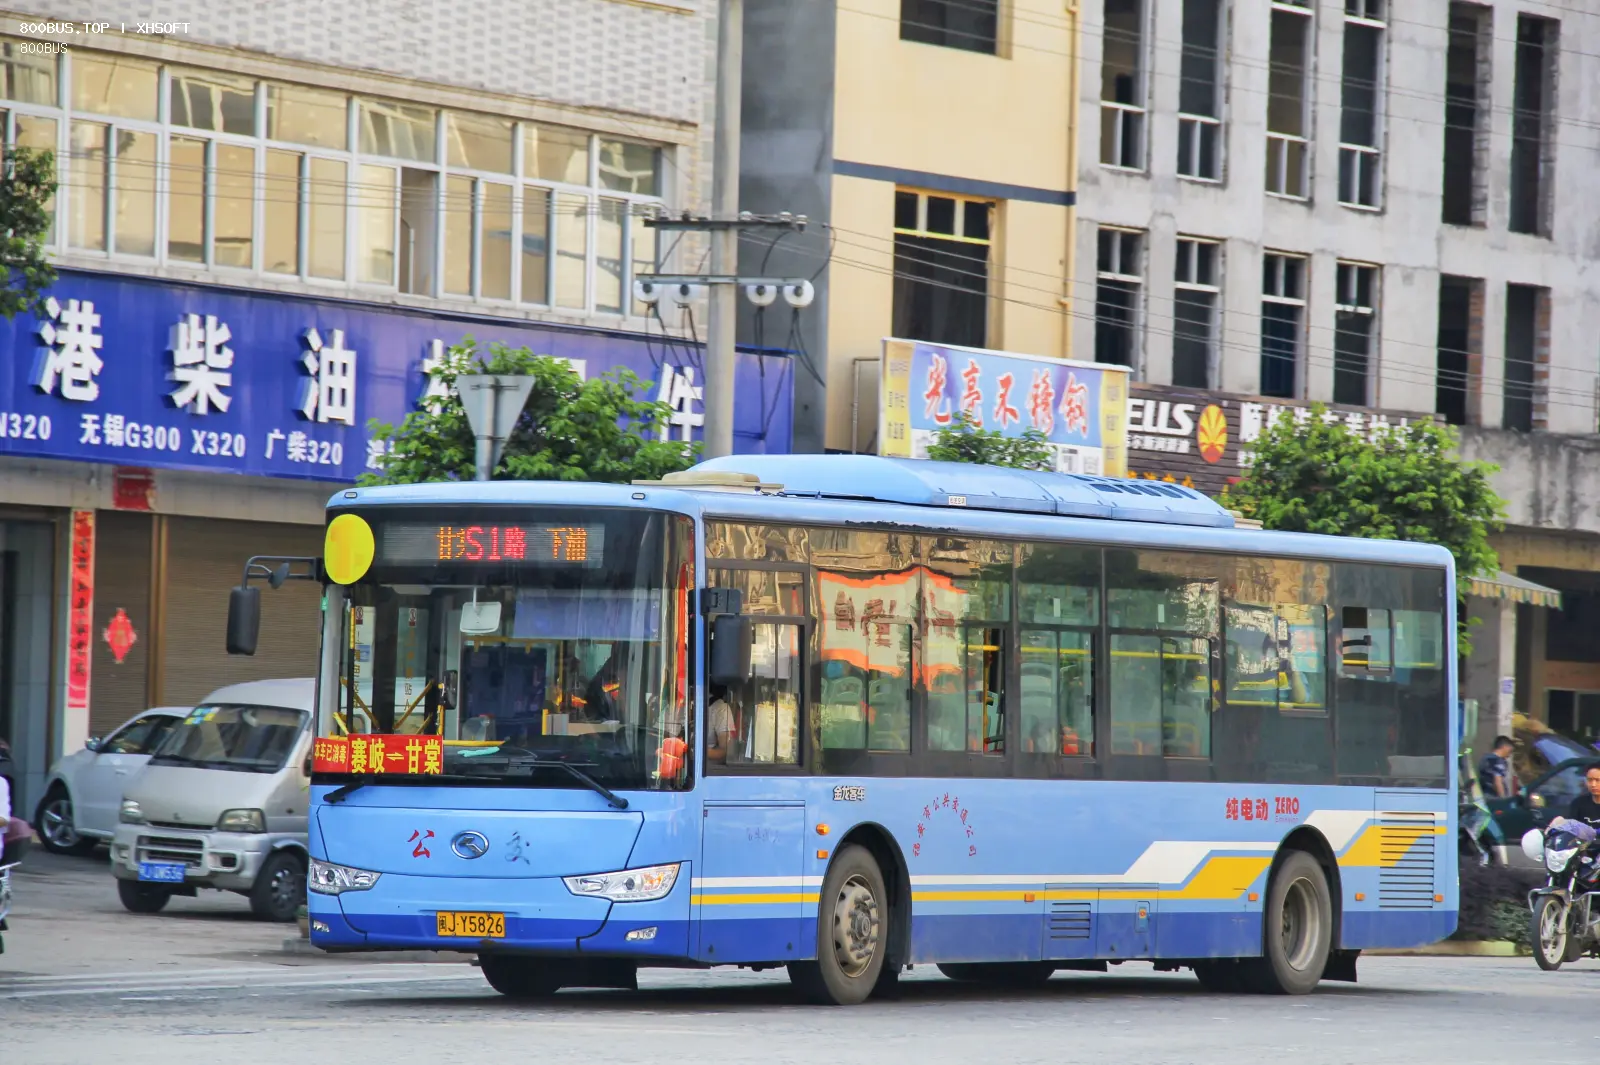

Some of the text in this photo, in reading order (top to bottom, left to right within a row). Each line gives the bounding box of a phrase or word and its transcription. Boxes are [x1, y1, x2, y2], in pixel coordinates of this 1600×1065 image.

[79, 413, 181, 452] 无锡G300
[191, 428, 246, 458] X320
[264, 428, 344, 466] 广柴320
[314, 741, 347, 764] 本车已消毒
[351, 738, 441, 775] 赛岐 甘棠
[832, 785, 865, 801] 金龙客车
[1225, 797, 1268, 821] 纯电动
[1274, 796, 1300, 815] ZERO
[407, 829, 435, 858] 公
